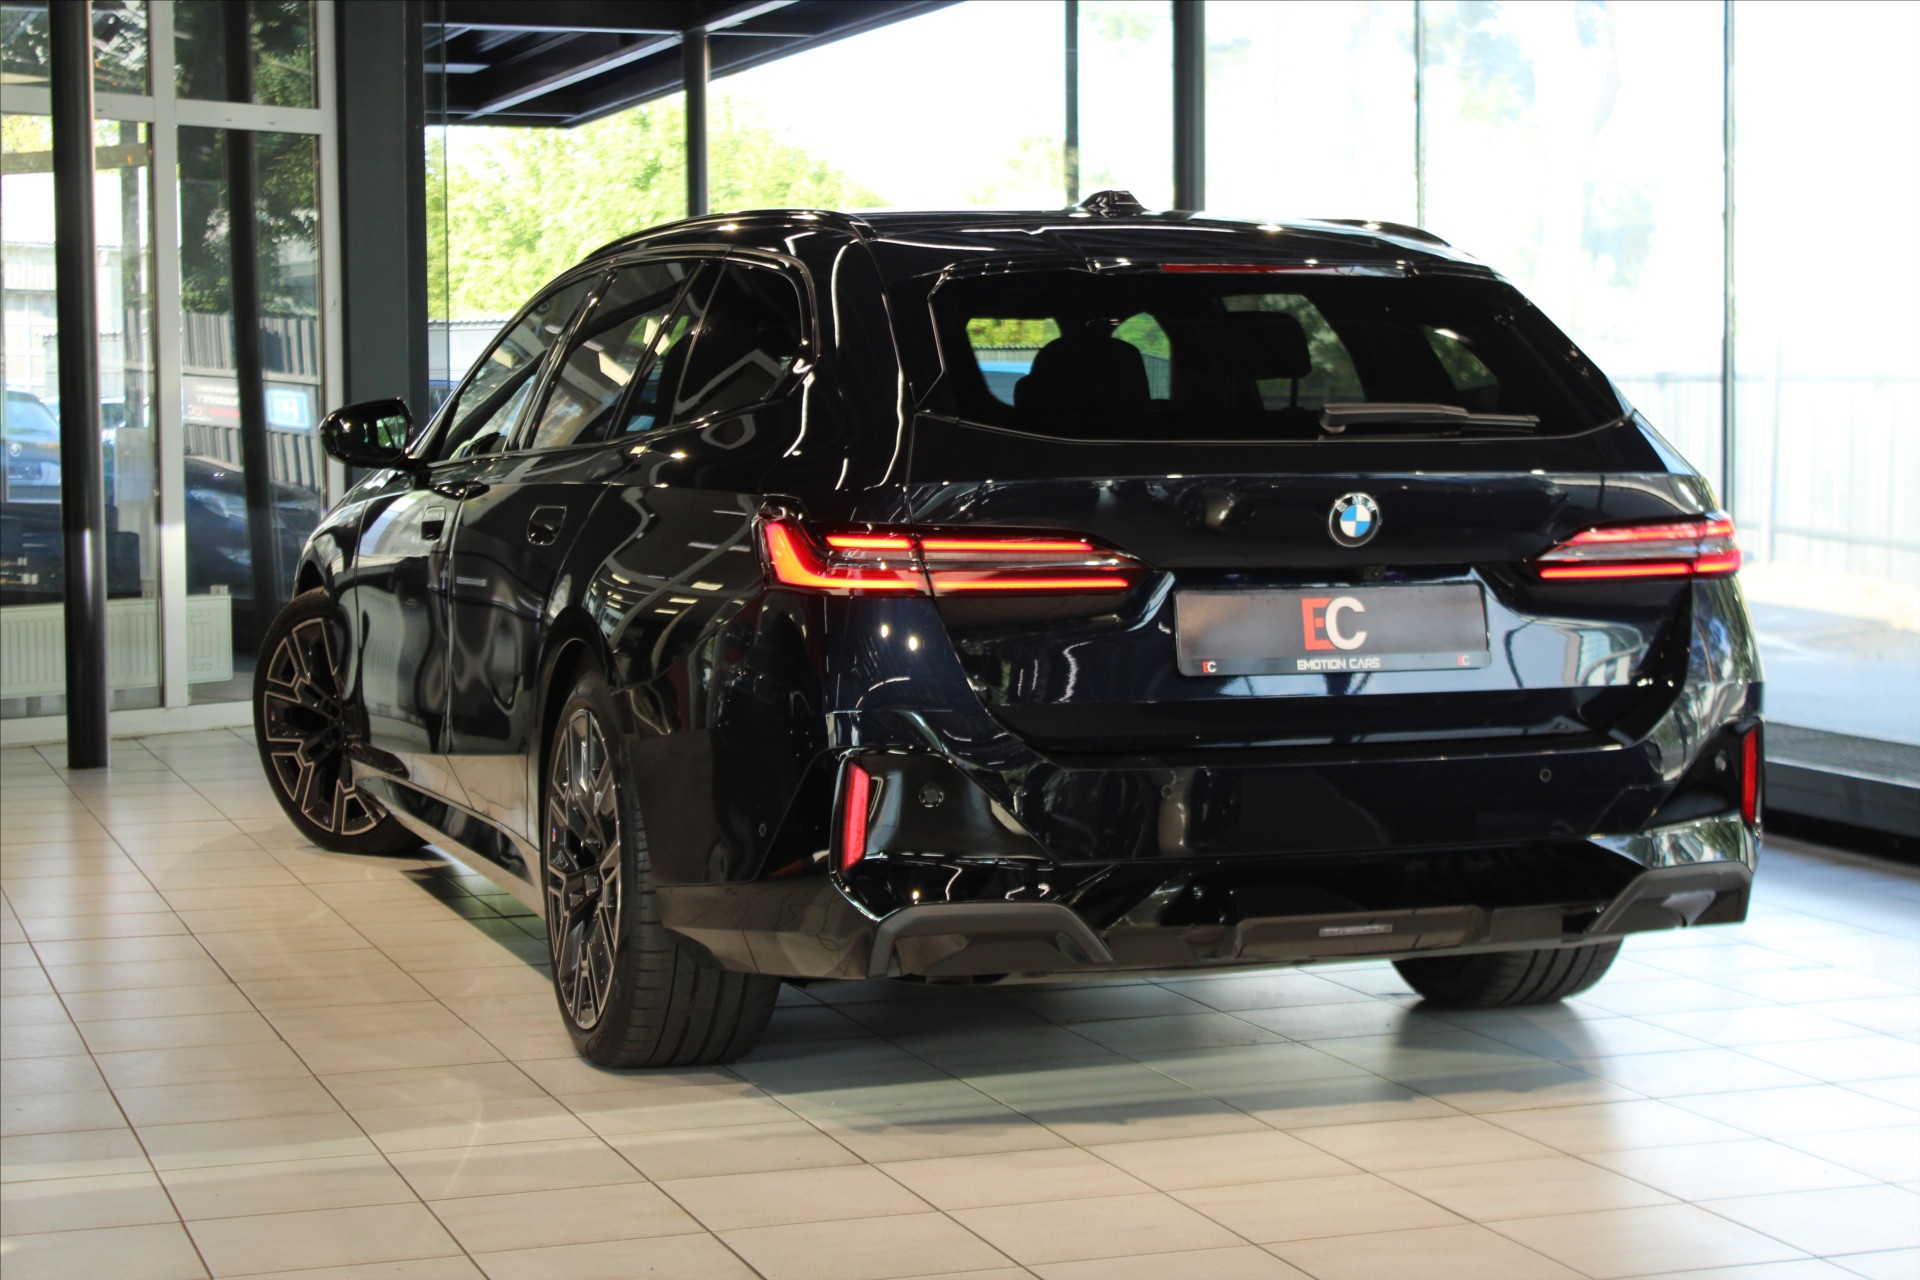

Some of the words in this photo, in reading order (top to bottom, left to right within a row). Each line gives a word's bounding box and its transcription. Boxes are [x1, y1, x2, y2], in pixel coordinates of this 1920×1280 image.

[1336, 494, 1376, 512] BMW
[1301, 596, 1367, 651] EC
[1202, 660, 1217, 673] EC
[1296, 658, 1346, 671] EMOTION
[1349, 657, 1380, 669] CARS
[1457, 654, 1471, 667] EC
